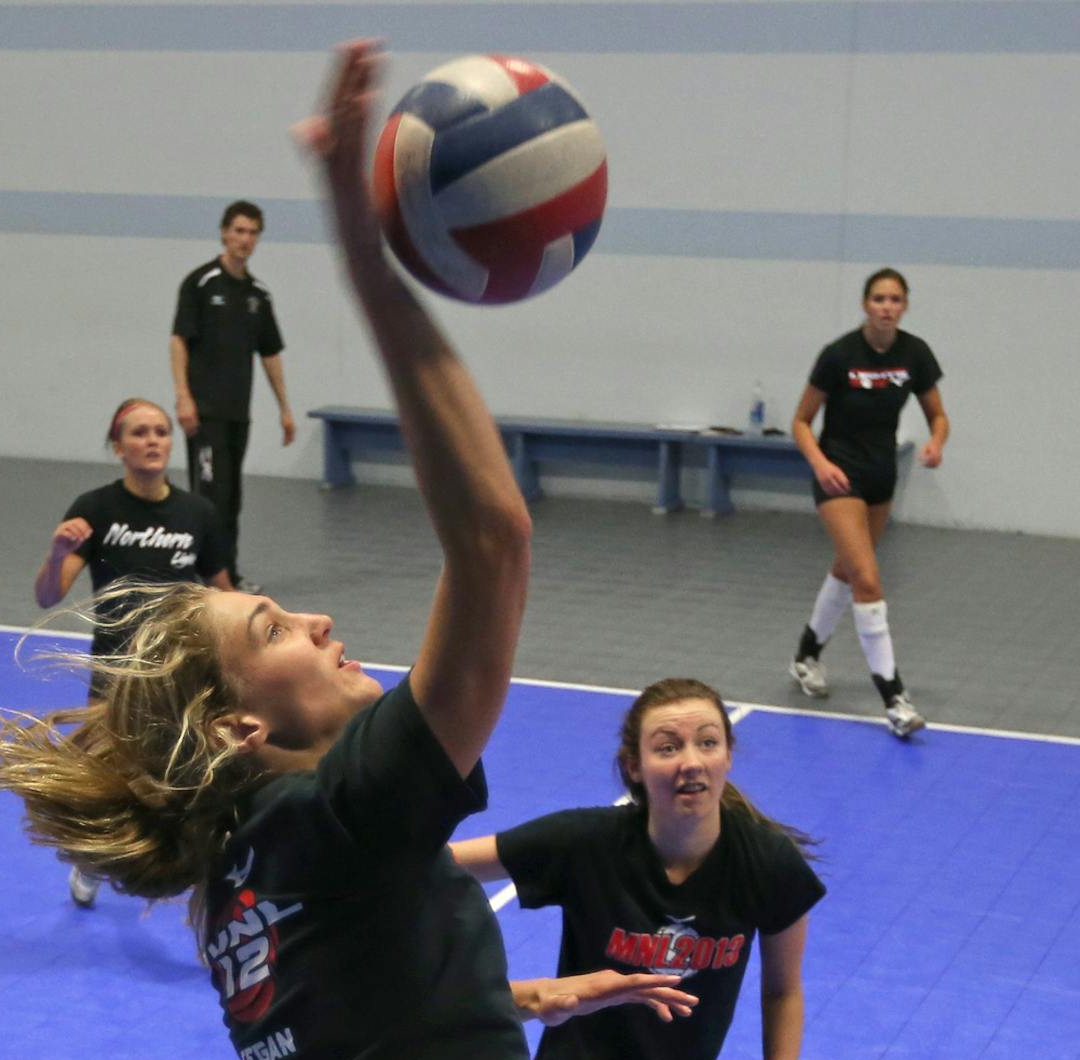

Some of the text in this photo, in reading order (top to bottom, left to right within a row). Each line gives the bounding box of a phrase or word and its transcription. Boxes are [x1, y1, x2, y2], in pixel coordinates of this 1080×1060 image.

[102, 521, 195, 551] Northern
[216, 935, 271, 1000] 12
[604, 926, 746, 971] MNL2013
